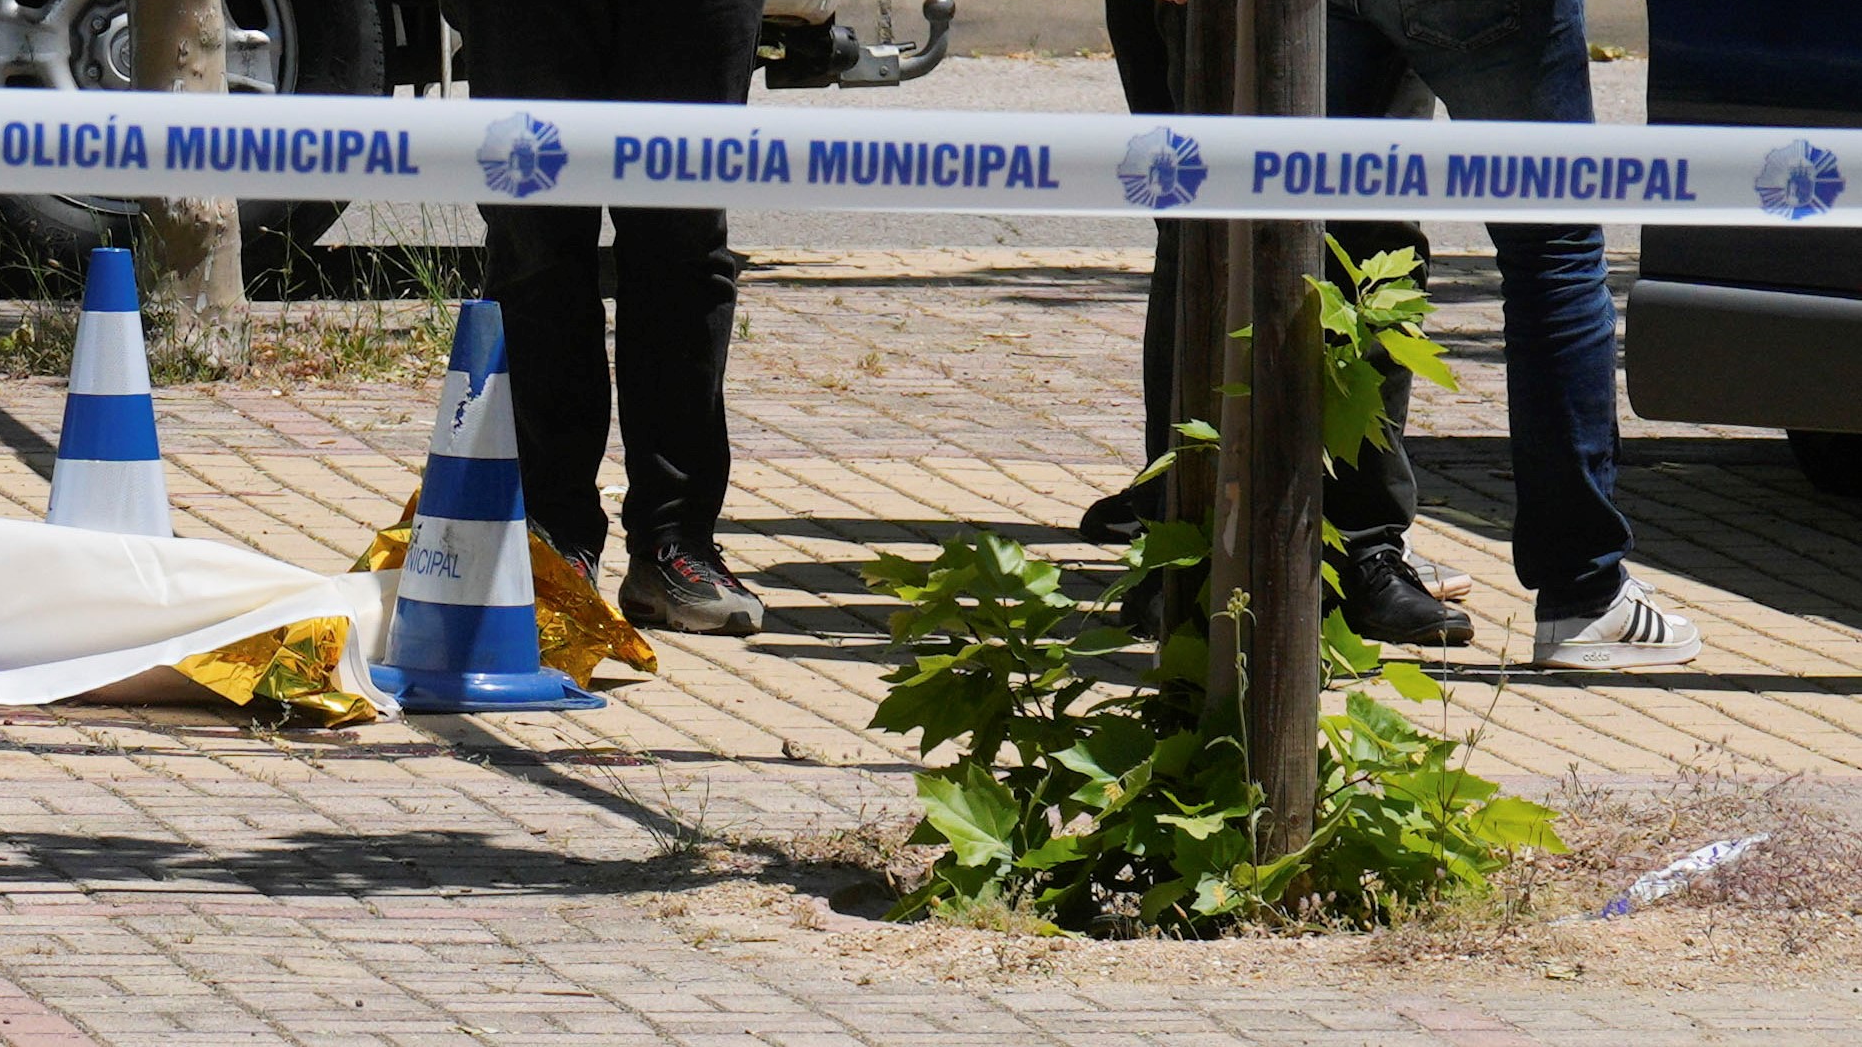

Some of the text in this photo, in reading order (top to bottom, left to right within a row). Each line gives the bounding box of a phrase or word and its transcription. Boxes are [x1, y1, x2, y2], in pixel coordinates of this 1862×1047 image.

[165, 125, 419, 176] MUNICIPAL
[613, 129, 790, 183] POLICÍA
[808, 139, 1058, 190] MUNICIPAL
[1253, 143, 1428, 197] POLICÍA
[1445, 154, 1696, 202] MUNICIPAL
[405, 546, 462, 579] NICIPAL
